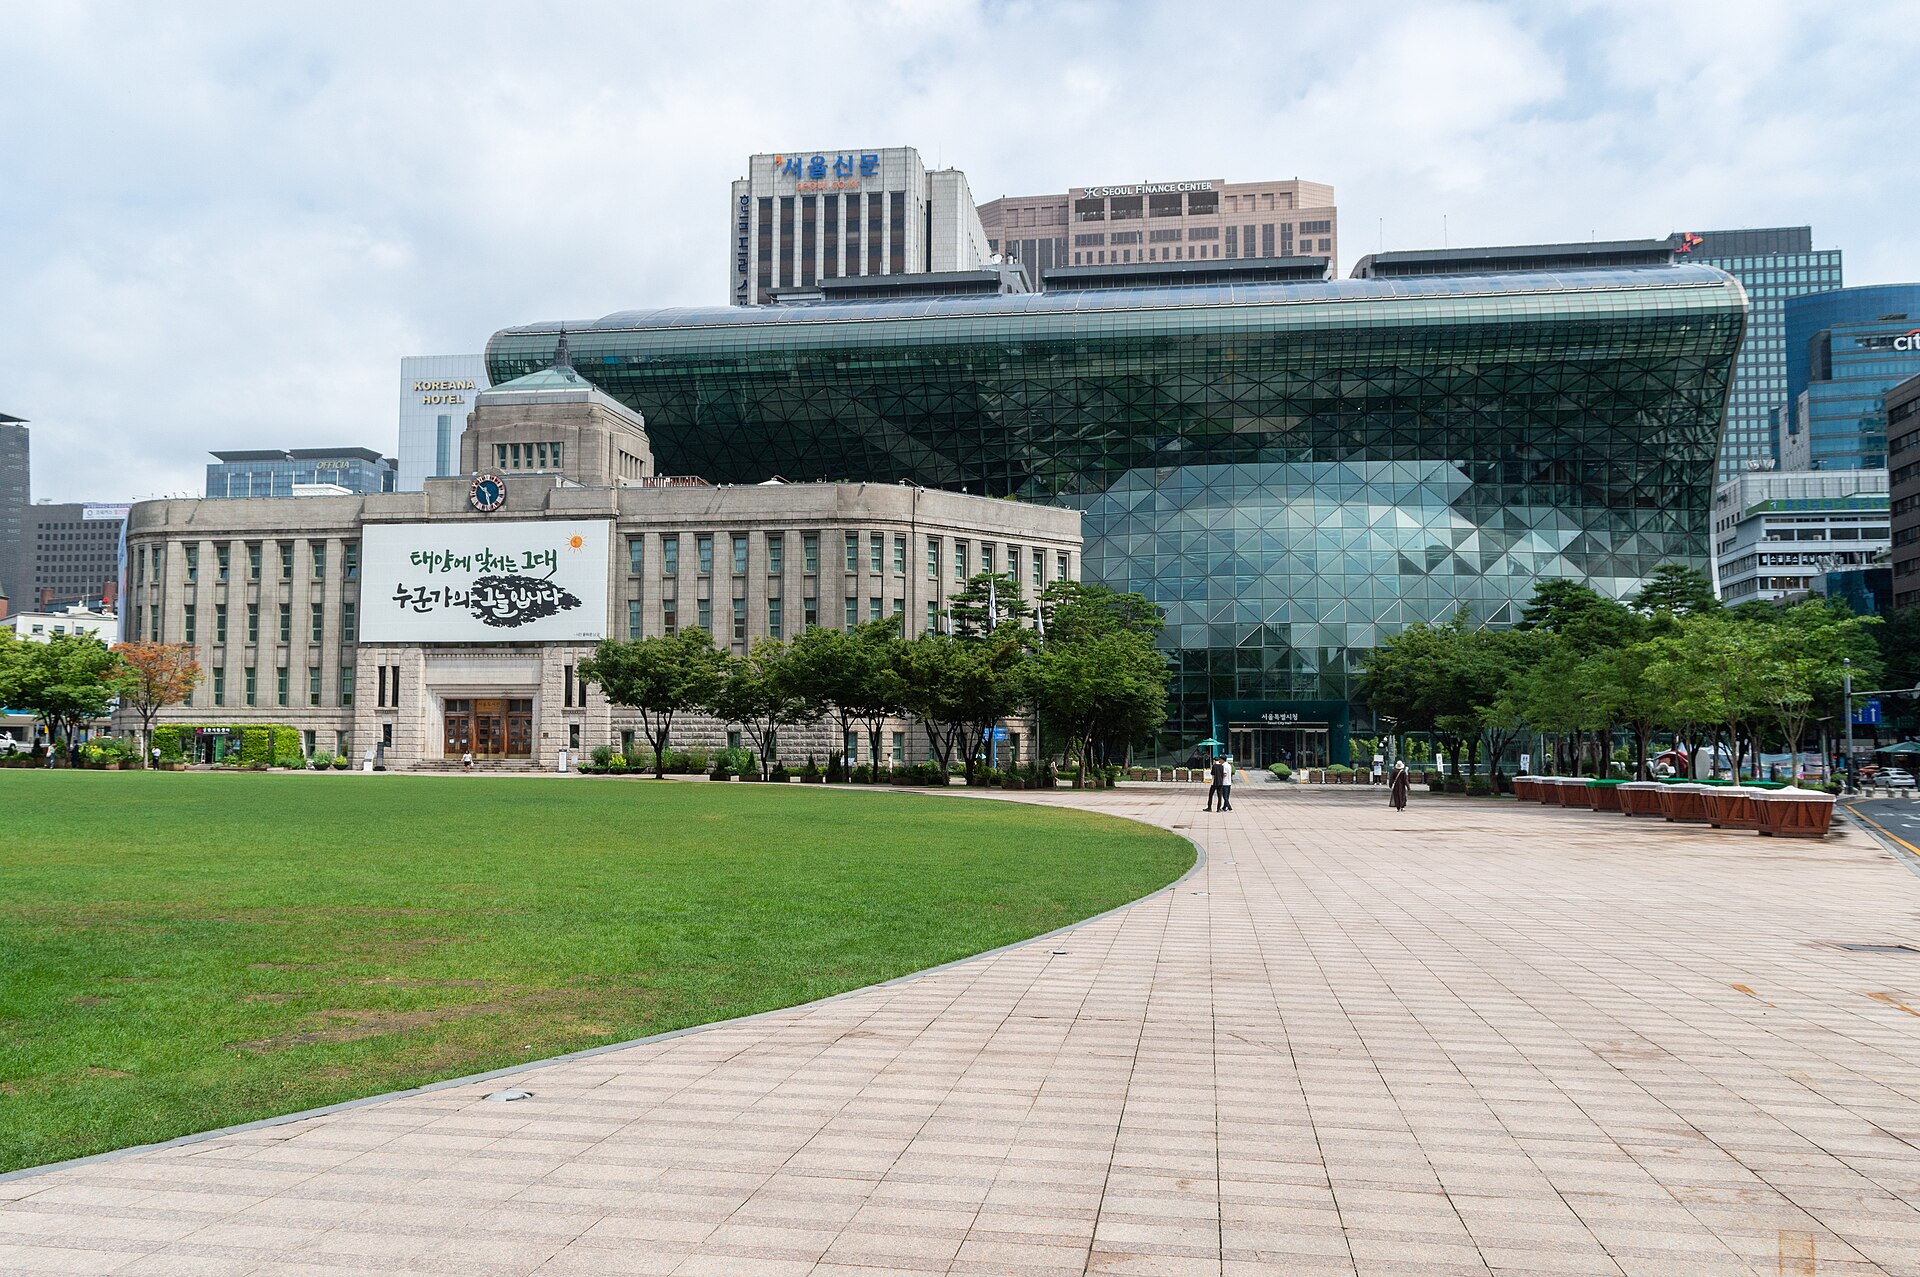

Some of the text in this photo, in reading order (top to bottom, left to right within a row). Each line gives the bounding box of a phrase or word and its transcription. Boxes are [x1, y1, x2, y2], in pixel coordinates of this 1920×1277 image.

[782, 154, 880, 179] 서울신문
[796, 180, 860, 191] seoul.co.kr
[1102, 186, 1133, 196] SEOUL
[1135, 184, 1176, 194] FINANCE
[1177, 182, 1212, 192] CENTER
[413, 380, 476, 391] KOREANA
[422, 394, 464, 405] HOTEL
[316, 461, 350, 469] OFFICIA
[410, 547, 557, 574] 태양에 맞서는 그대
[392, 582, 563, 618] 누군가의 그늘입니다
[1261, 713, 1298, 721] 서울특별시청
